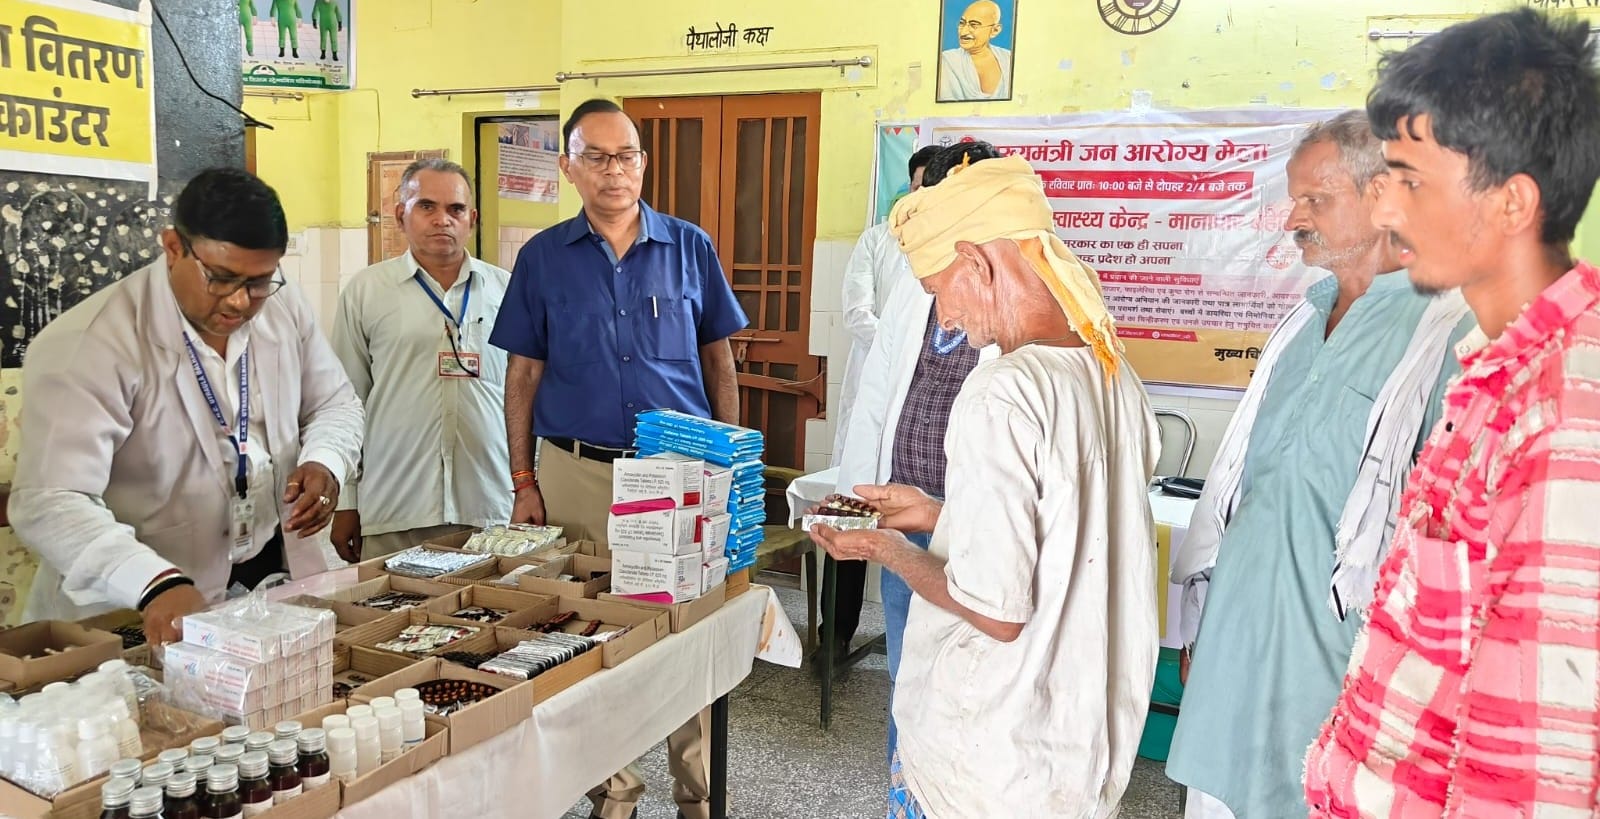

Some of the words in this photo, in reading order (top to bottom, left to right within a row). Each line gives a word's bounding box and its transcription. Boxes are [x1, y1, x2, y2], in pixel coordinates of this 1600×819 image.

[743, 27, 774, 47] कक्ष
[21, 15, 145, 89] वितरण
[0, 86, 110, 147] काउंटर
[996, 139, 1074, 162] ख्यमंत्री
[1080, 143, 1118, 162] जन
[1124, 139, 1210, 164] आरोग्य
[1215, 139, 1270, 163] मेला
[1049, 178, 1075, 191] रविवार
[1100, 181, 1125, 191] 10:00
[1128, 179, 1142, 191] बजे
[1145, 179, 1153, 191] से
[1156, 179, 1183, 192] दोपहर
[1208, 180, 1225, 192] बजे
[1228, 182, 1247, 192] तक
[1109, 206, 1149, 231] केन्द्र
[1100, 240, 1114, 249] का
[1117, 241, 1134, 250] एक
[1137, 239, 1149, 250] ही
[1152, 241, 1184, 251] सपना
[1098, 252, 1122, 264] प्रदेश
[1124, 253, 1137, 264] हो
[1215, 347, 1243, 362] मुख्य
